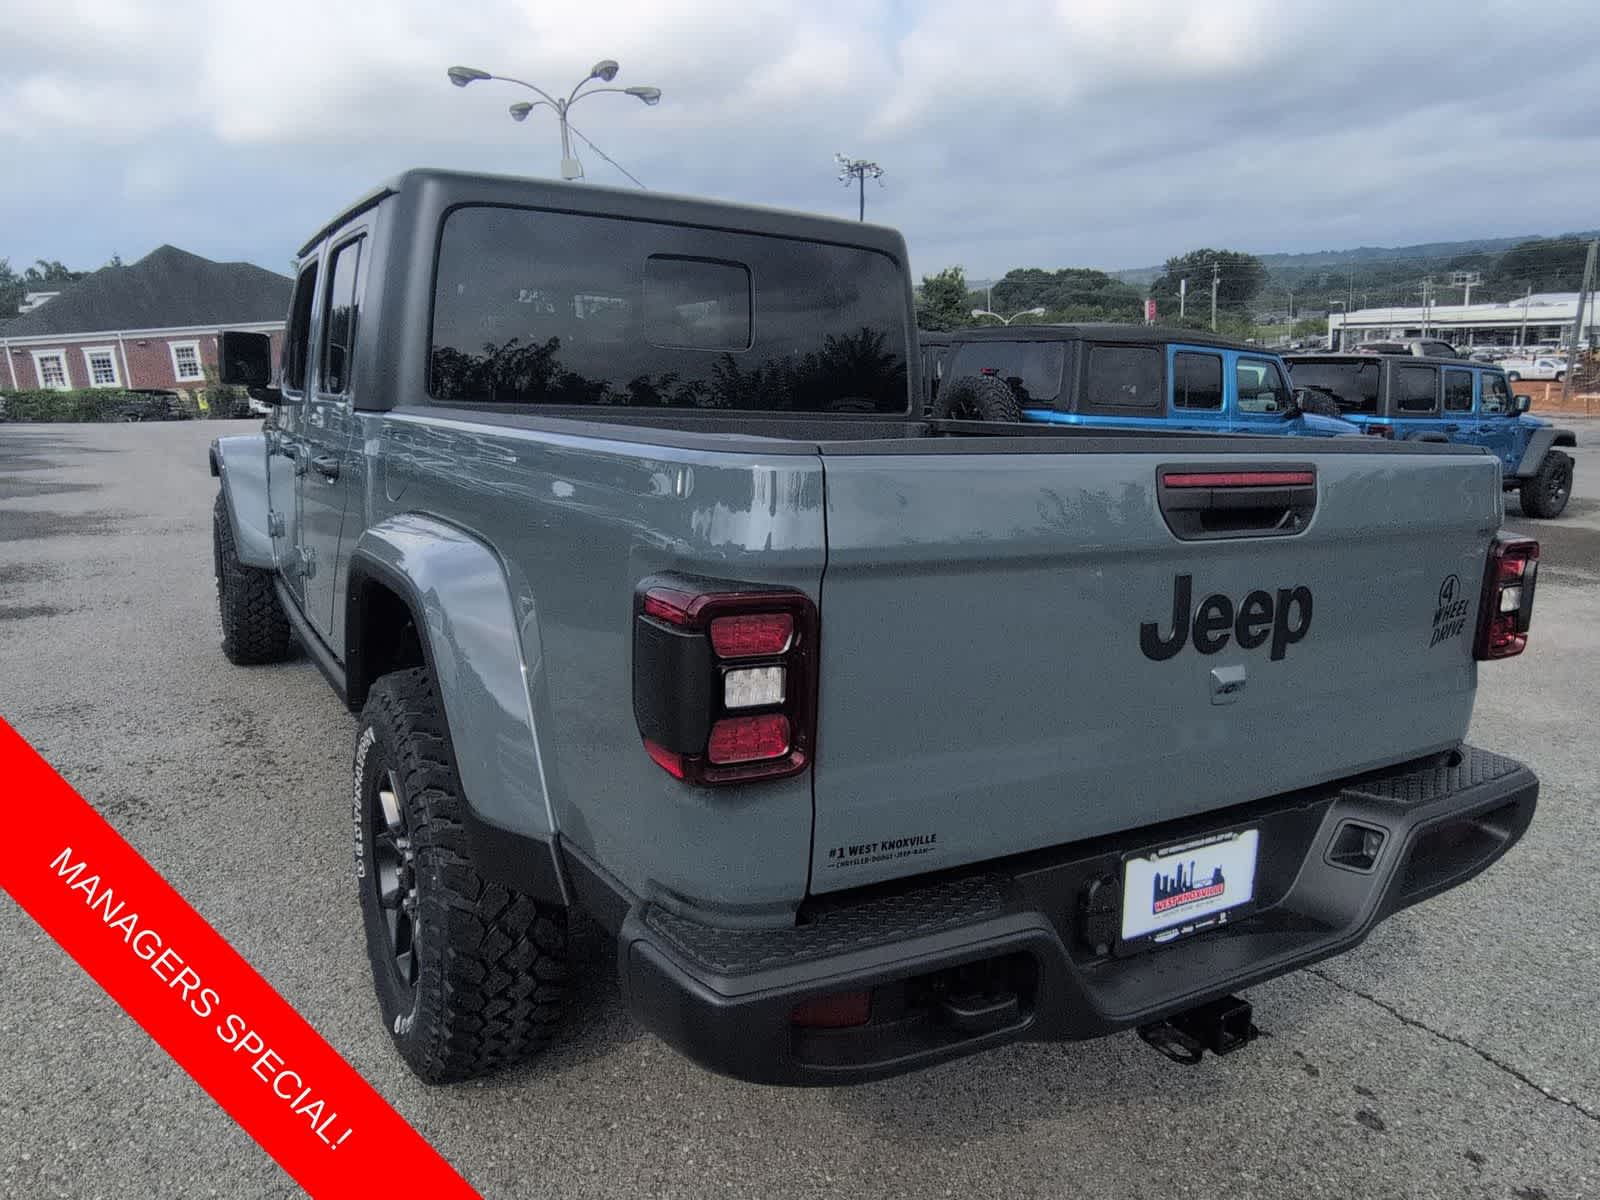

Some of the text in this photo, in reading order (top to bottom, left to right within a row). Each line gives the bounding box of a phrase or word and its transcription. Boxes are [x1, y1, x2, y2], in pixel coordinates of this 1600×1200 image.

[1140, 575, 1312, 661] Jeep
[1432, 600, 1469, 627] WHEEL
[1429, 619, 1465, 648] DRIVE
[829, 833, 937, 859] #1 WEST KNOXVILLE
